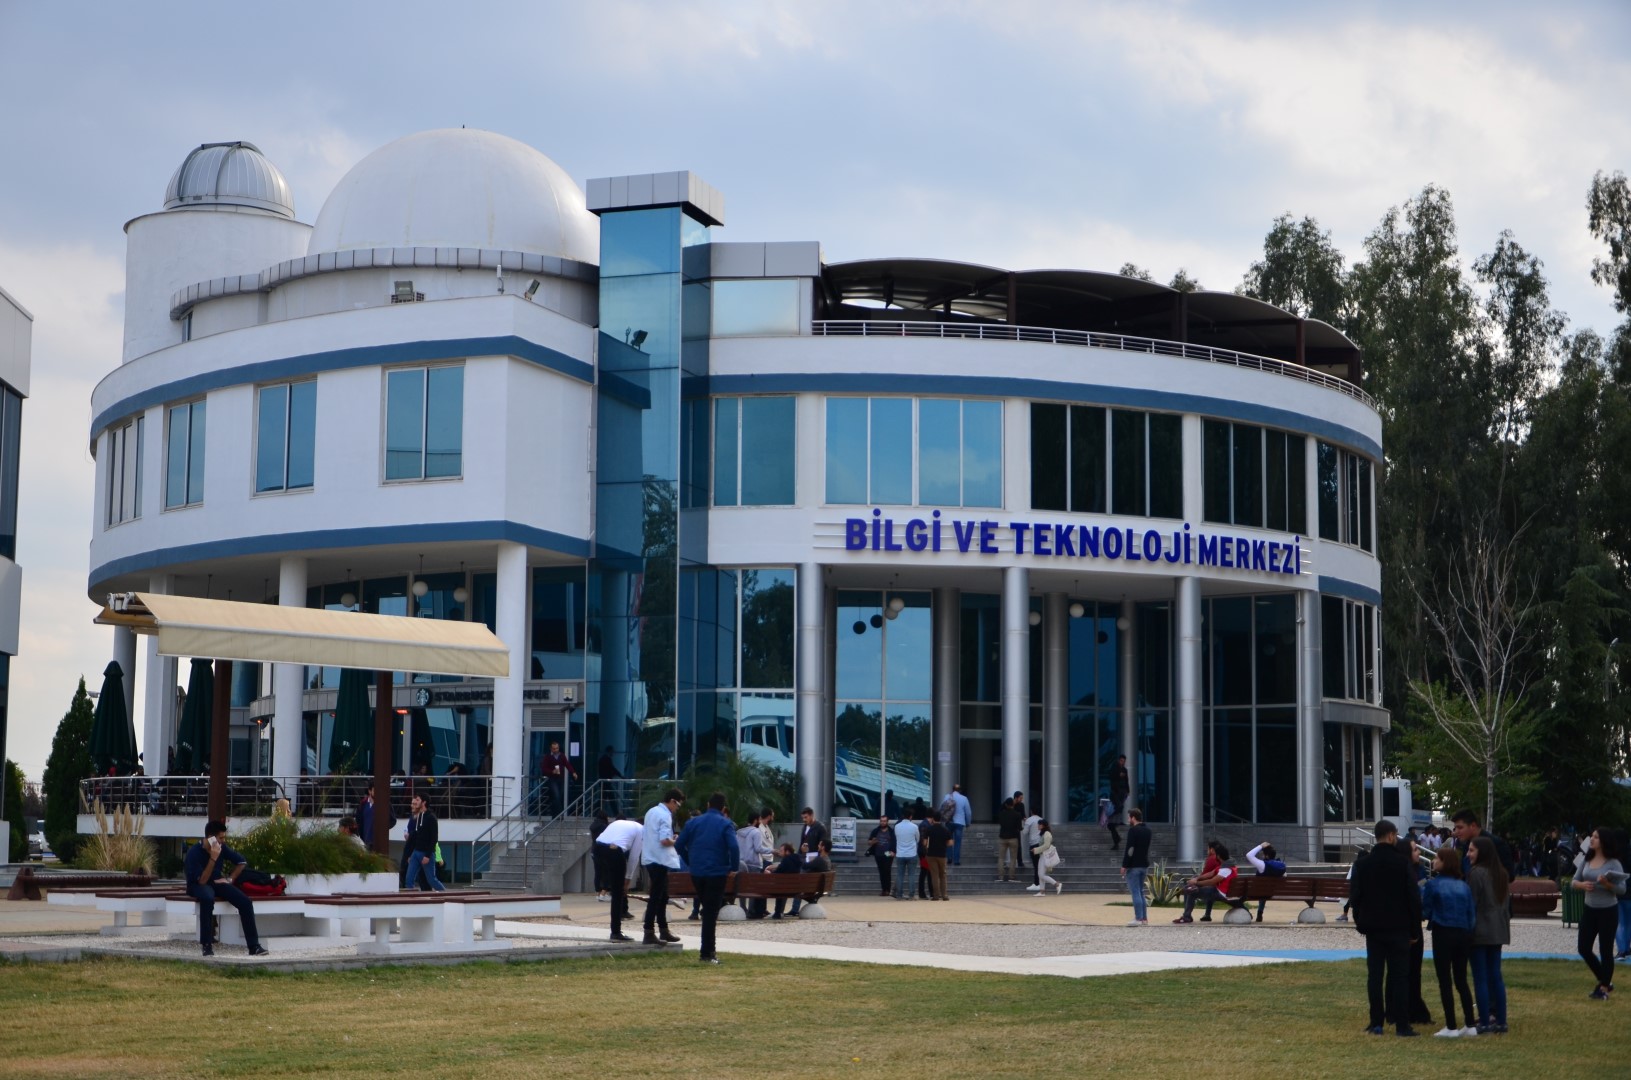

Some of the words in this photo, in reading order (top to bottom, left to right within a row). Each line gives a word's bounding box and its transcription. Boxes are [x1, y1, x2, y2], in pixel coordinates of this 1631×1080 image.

[845, 508, 941, 552] BİLGİ
[953, 520, 999, 554] VE
[1009, 521, 1192, 564] TEKNOLOJİ
[1198, 535, 1302, 574] MERKEZİ
[434, 690, 494, 701] STARBUCK
